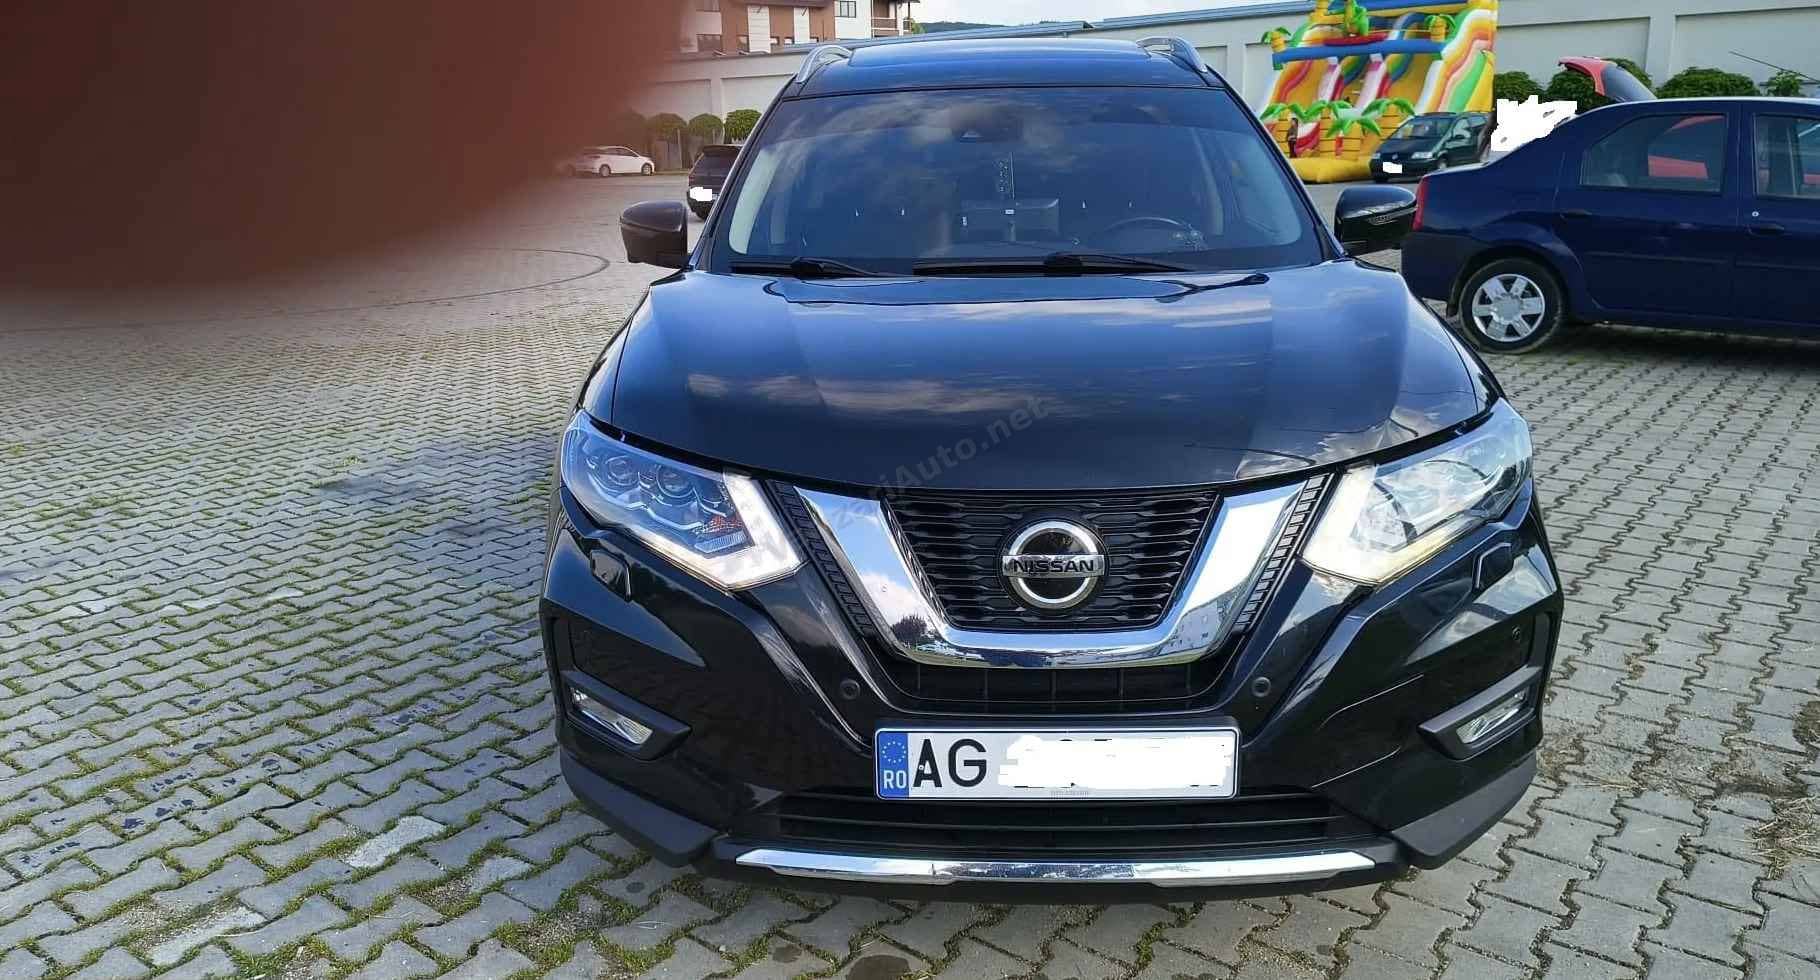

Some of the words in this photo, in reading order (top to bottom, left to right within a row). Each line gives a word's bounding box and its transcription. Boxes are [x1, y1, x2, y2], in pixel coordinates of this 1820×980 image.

[1013, 559, 1094, 573] NISSAN
[913, 738, 987, 788] AG
[883, 770, 907, 789] RO
